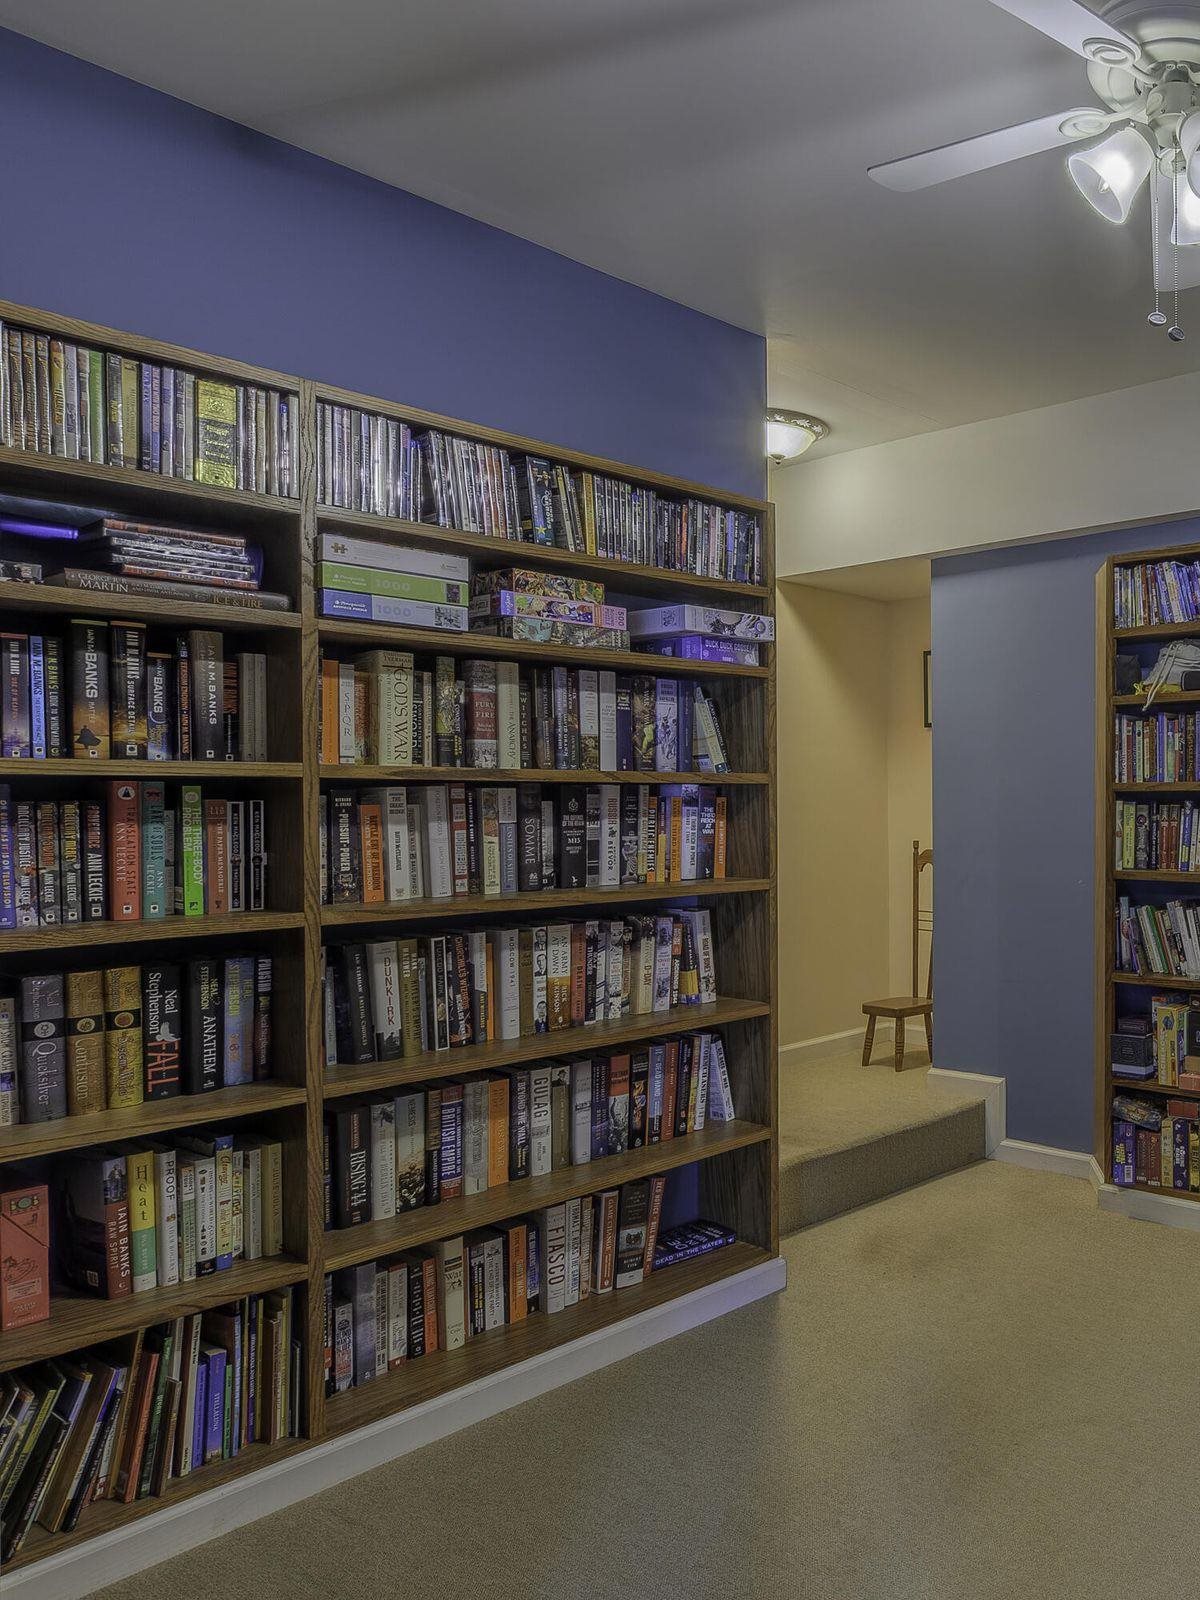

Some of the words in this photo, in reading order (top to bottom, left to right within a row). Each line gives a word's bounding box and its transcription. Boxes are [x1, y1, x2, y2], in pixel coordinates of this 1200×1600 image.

[79, 580, 129, 593] MARTIN
[214, 596, 230, 604] ICE
[242, 599, 263, 609] FIRE
[378, 605, 412, 617] 1000
[33, 642, 41, 657] IAIN
[33, 670, 42, 695] BANKS
[154, 677, 163, 713] BANKS
[393, 670, 408, 717] GOD'S
[394, 719, 408, 760] WAR
[507, 722, 515, 759] ANARCHY
[192, 808, 201, 824] THE
[608, 798, 617, 824] RUSSIA
[647, 810, 655, 837] PUBLIC
[116, 822, 125, 841] ANN
[126, 807, 135, 866] TRANSLATION
[183, 807, 191, 851] PROBLEM
[339, 814, 349, 844] PURSUIT
[525, 818, 535, 863] SOMME
[88, 853, 101, 872] ANN
[116, 847, 125, 882] LECKIE
[193, 829, 203, 885] THREE-BODY
[340, 848, 350, 871] POWER
[647, 841, 655, 871] ENEMIES
[21, 875, 30, 886] ANN
[45, 874, 53, 884] ANN
[67, 872, 76, 884] ANN
[89, 874, 102, 901] LECKIE
[127, 871, 135, 895] STATE
[21, 887, 30, 905] LECKIE
[45, 885, 54, 902] LECKIE
[68, 884, 76, 901] LECKIE
[552, 936, 559, 945] AT
[561, 936, 568, 948] AN
[455, 937, 465, 978] CHURCHILL'S
[201, 966, 209, 1010] STEPHENSON
[210, 979, 218, 999] NEAL
[229, 964, 240, 1016] STEPHENSON
[384, 957, 394, 1025] DUNKIRK
[146, 973, 162, 1034] Stephenson
[164, 990, 178, 1014] Neal
[204, 1015, 216, 1073] ANATHEM
[32, 1042, 58, 1105] Quicksilver
[75, 1038, 96, 1099] Confusion
[147, 1040, 180, 1092] FALL
[533, 1078, 548, 1118] GULAG
[442, 1108, 455, 1143] BRITISH
[518, 1111, 526, 1124] THE
[518, 1126, 526, 1145] WALL
[350, 1150, 366, 1190] RISING
[442, 1145, 456, 1176] EMPIRE
[137, 1165, 148, 1220] Heat
[166, 1161, 175, 1200] PROOF
[351, 1190, 366, 1206] '44
[117, 1207, 127, 1232] IAIN
[572, 1205, 580, 1228] THOMAS
[109, 1222, 117, 1239] RAW
[110, 1243, 118, 1270] SPIRIT
[120, 1237, 130, 1277] BANKS
[548, 1226, 564, 1285] FIASCO
[656, 1256, 673, 1265] DEAD
[702, 1239, 723, 1250] WATER
[571, 1270, 580, 1293] GAMBLE
